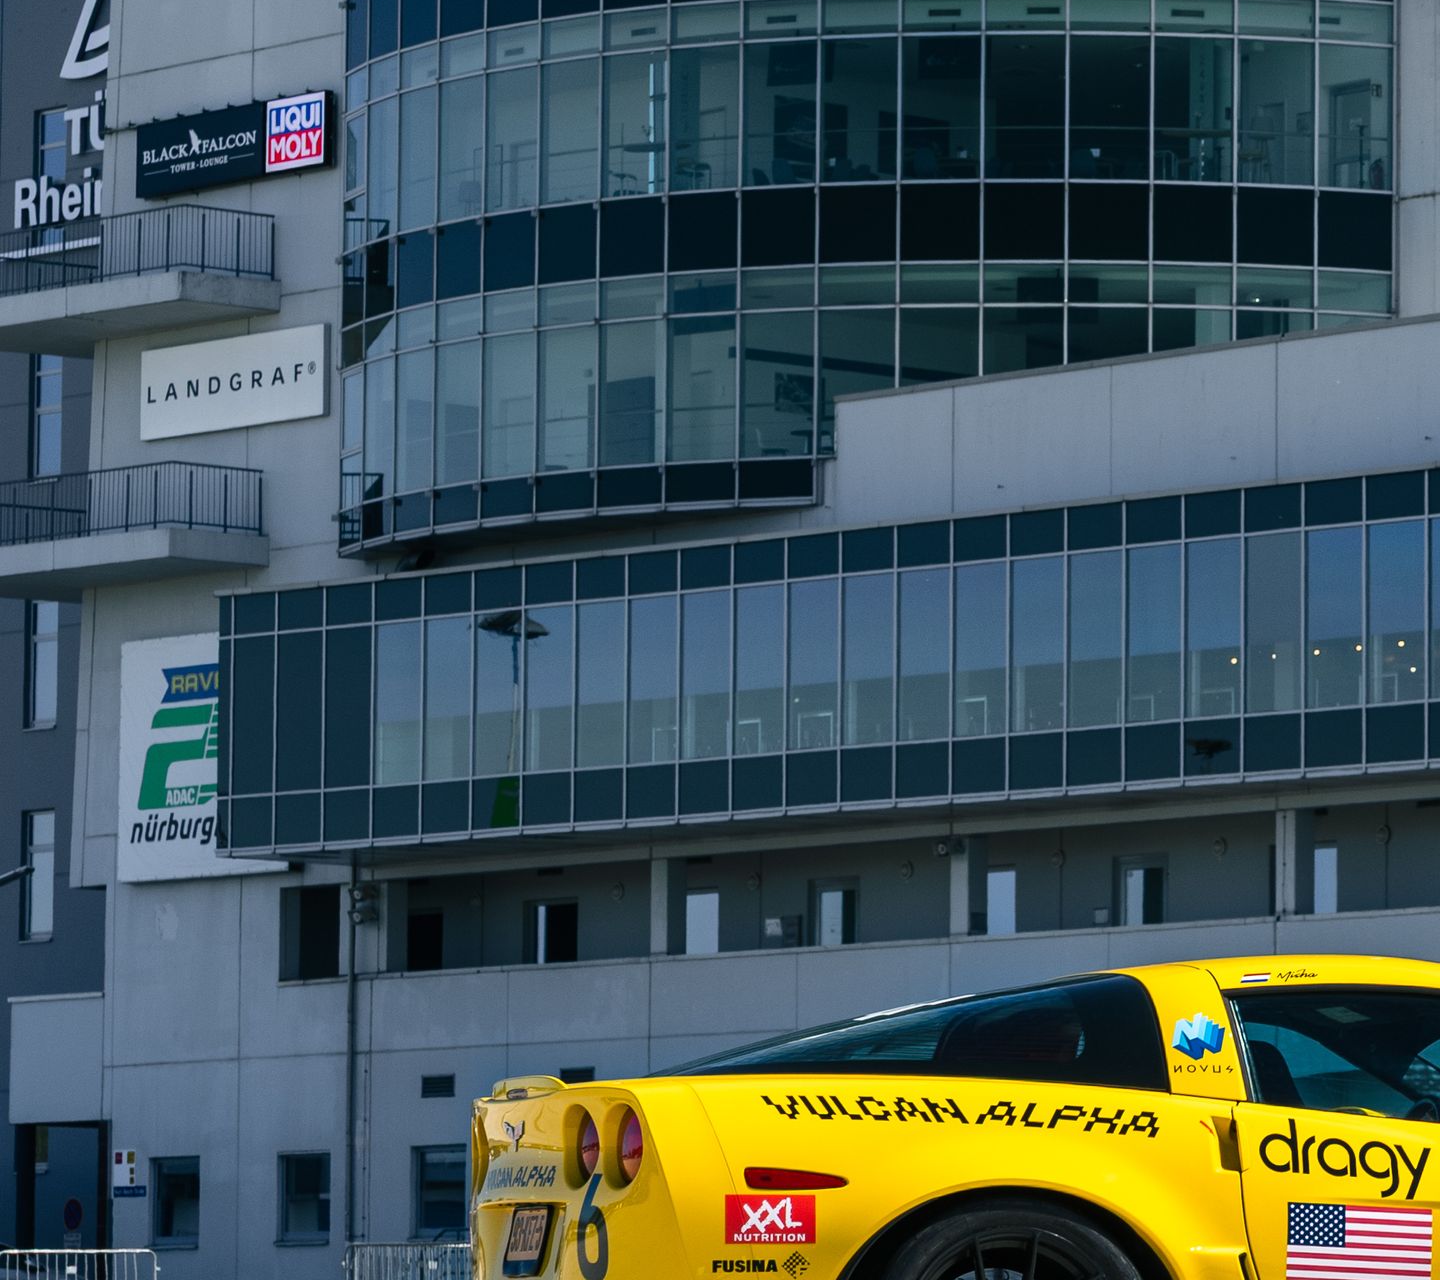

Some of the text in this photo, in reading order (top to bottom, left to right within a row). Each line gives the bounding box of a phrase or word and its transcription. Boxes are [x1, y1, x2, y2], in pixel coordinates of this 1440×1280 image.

[271, 105, 321, 134] LIQUI
[142, 130, 257, 166] BLACK FALCON
[269, 130, 322, 162] MOLY
[170, 155, 229, 174] TOWER LOUNGE
[14, 166, 102, 229] Rhei
[165, 788, 196, 807] ADAC
[130, 812, 220, 846] nürburg
[760, 1094, 1161, 1139] VULCAN ALPHA
[1259, 1118, 1432, 1200] dragy
[511, 1165, 557, 1188] ALPHA
[740, 1196, 803, 1234] XXL
[733, 1233, 806, 1242] NUTRITION
[711, 1259, 778, 1273] FUSINA
